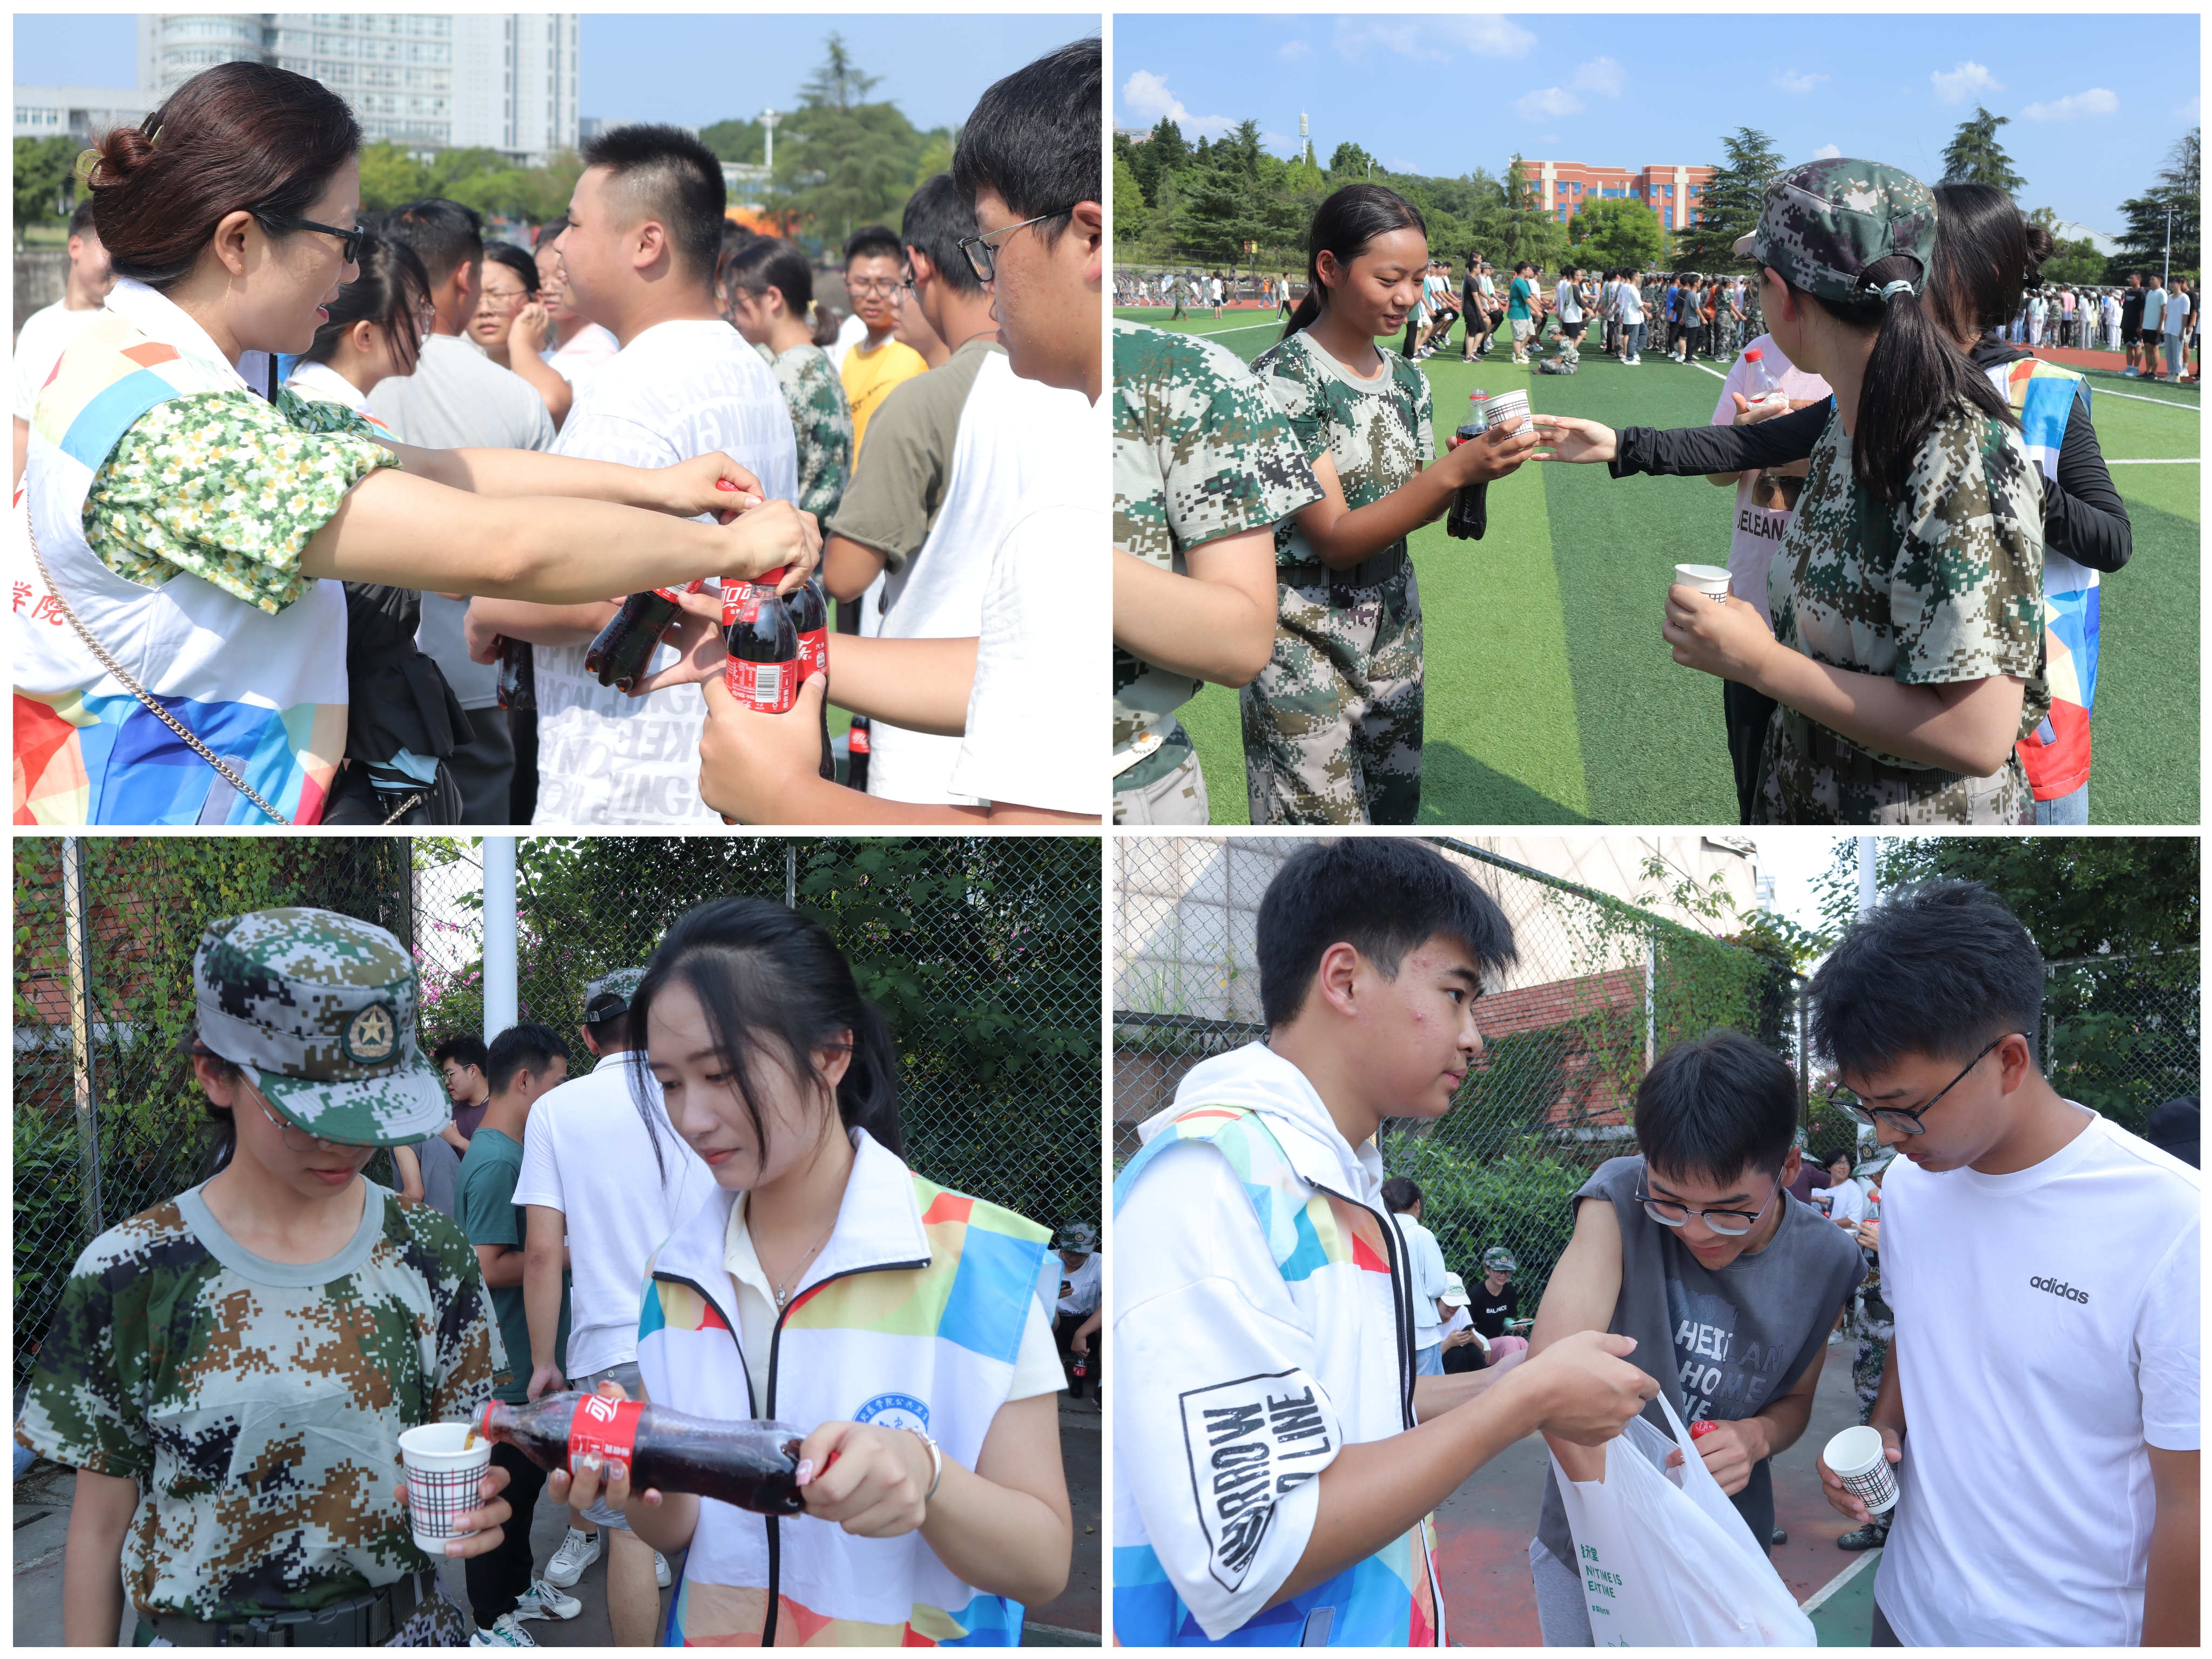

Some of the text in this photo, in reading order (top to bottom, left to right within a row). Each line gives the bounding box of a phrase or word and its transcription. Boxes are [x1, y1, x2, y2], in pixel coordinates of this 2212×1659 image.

[2030, 1276, 2089, 1304] adidas
[1675, 1320, 1784, 1374] HEILAN
[1680, 1360, 1768, 1405] HOME
[1266, 1386, 1331, 1461] LINE
[1613, 1573, 1623, 1586] IS
